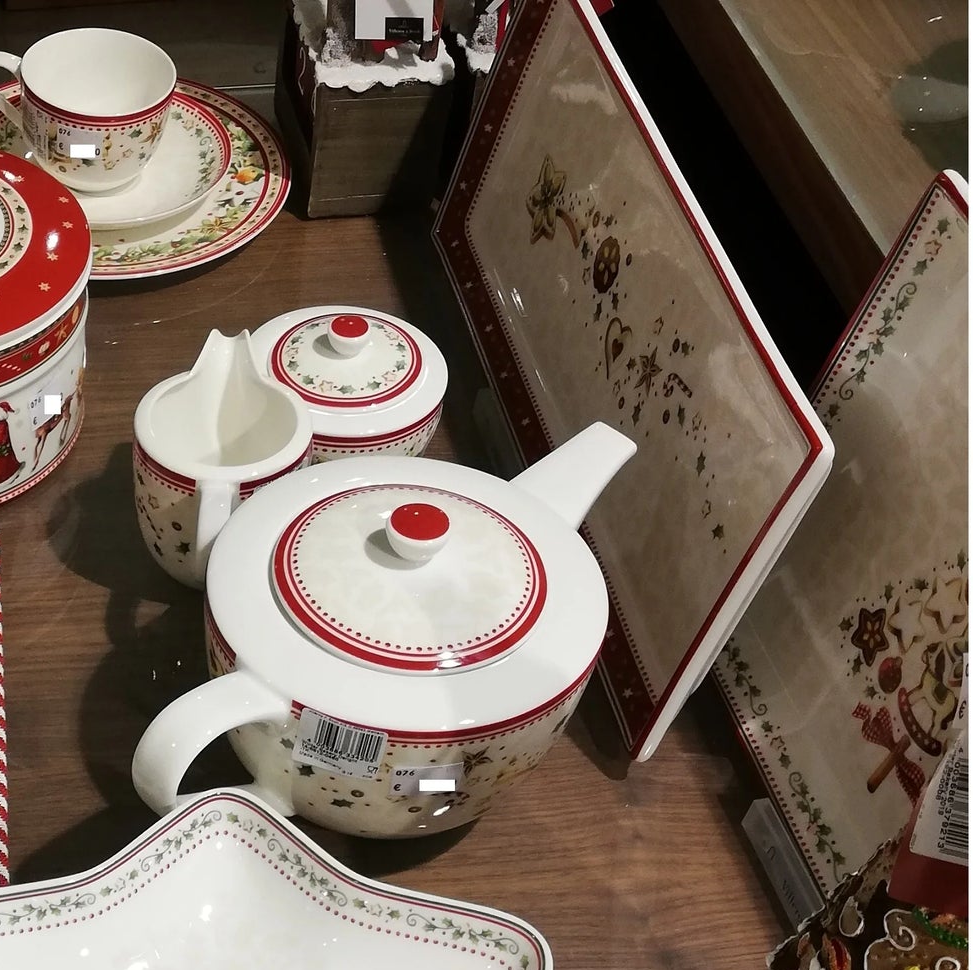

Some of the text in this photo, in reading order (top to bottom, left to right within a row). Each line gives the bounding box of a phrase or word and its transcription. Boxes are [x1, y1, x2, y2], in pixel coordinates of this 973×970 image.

[58, 128, 71, 137] 076
[395, 769, 415, 777] 076
[947, 761, 960, 803] 003686
[393, 783, 401, 791] €
[937, 807, 952, 849] 379213
